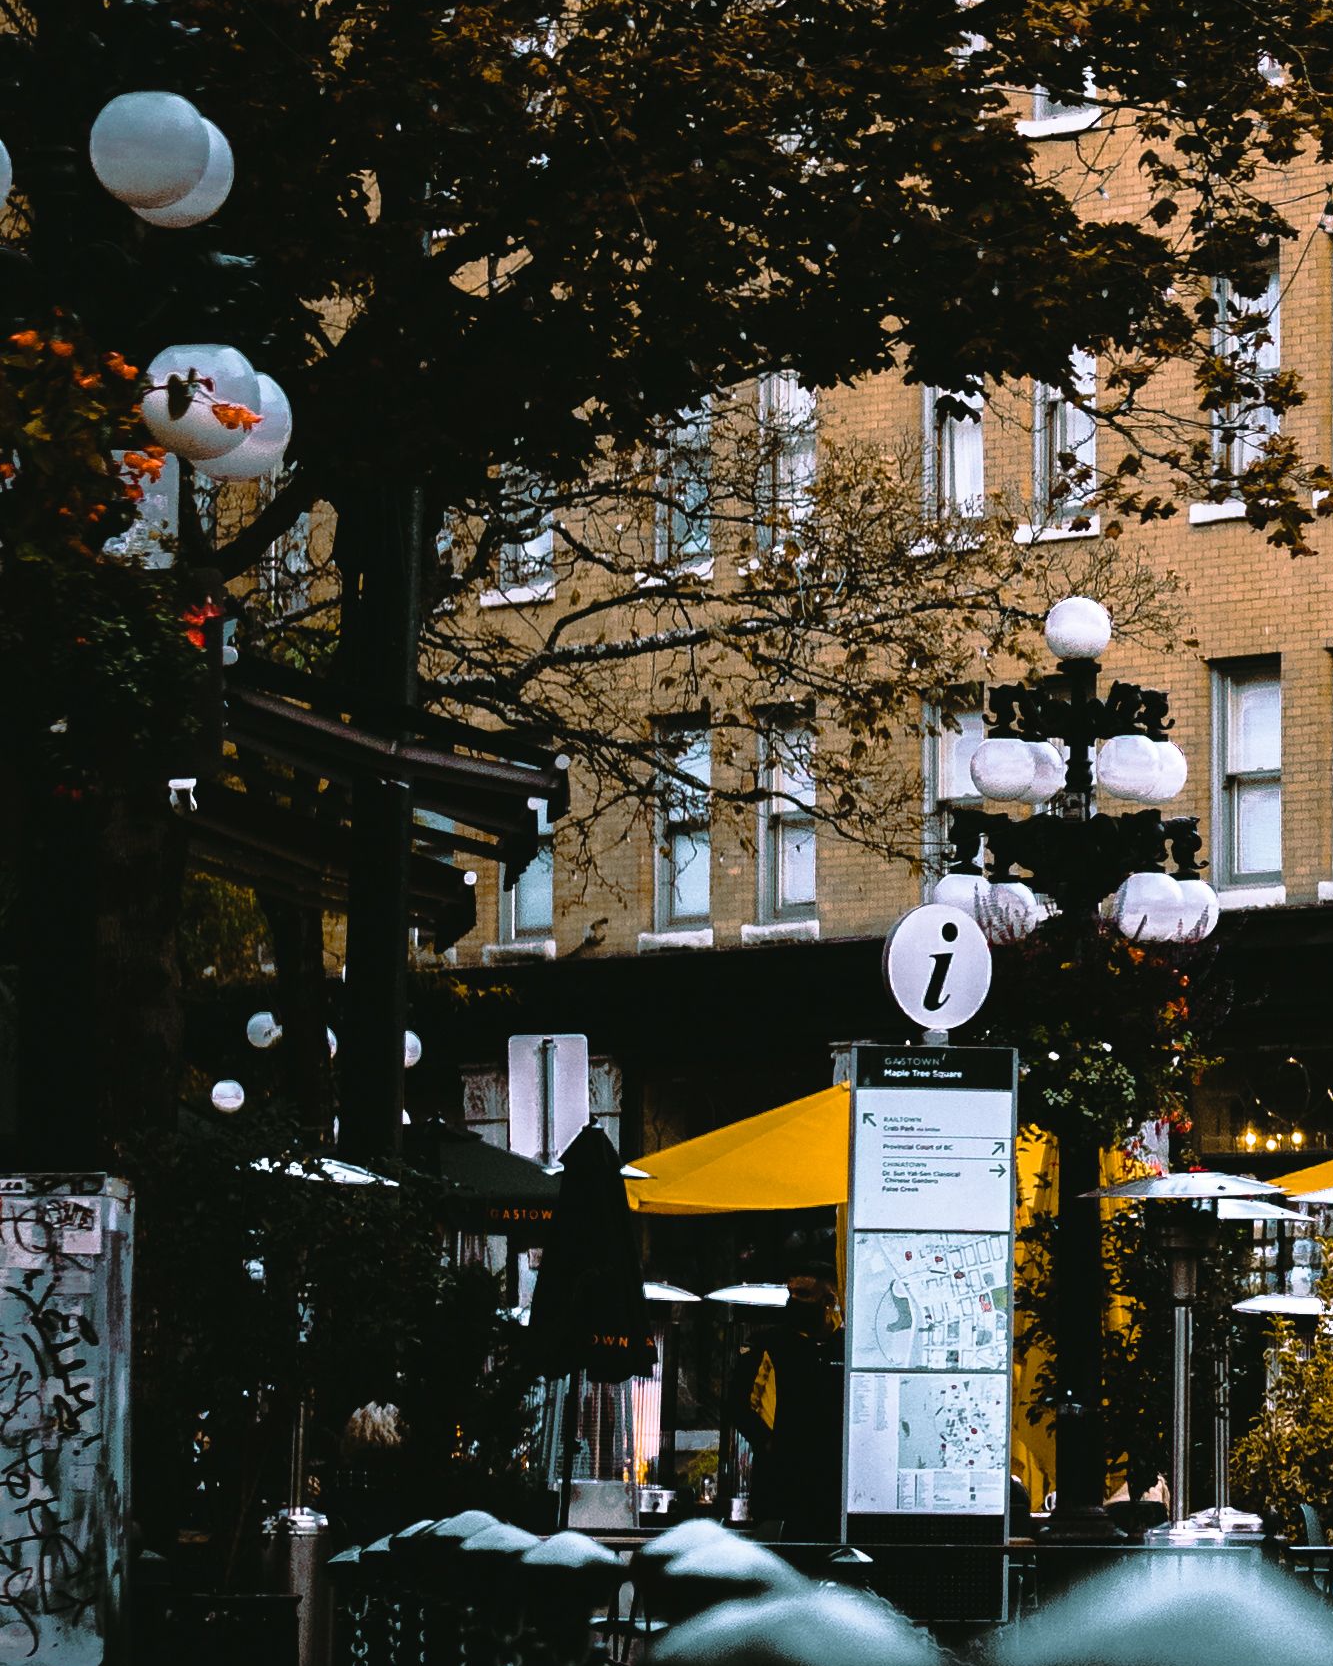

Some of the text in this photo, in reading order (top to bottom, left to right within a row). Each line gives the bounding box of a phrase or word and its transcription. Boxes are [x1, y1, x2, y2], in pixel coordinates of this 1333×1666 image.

[884, 1057, 940, 1066] GASTOWN
[883, 1069, 963, 1079] Maple Tree Square
